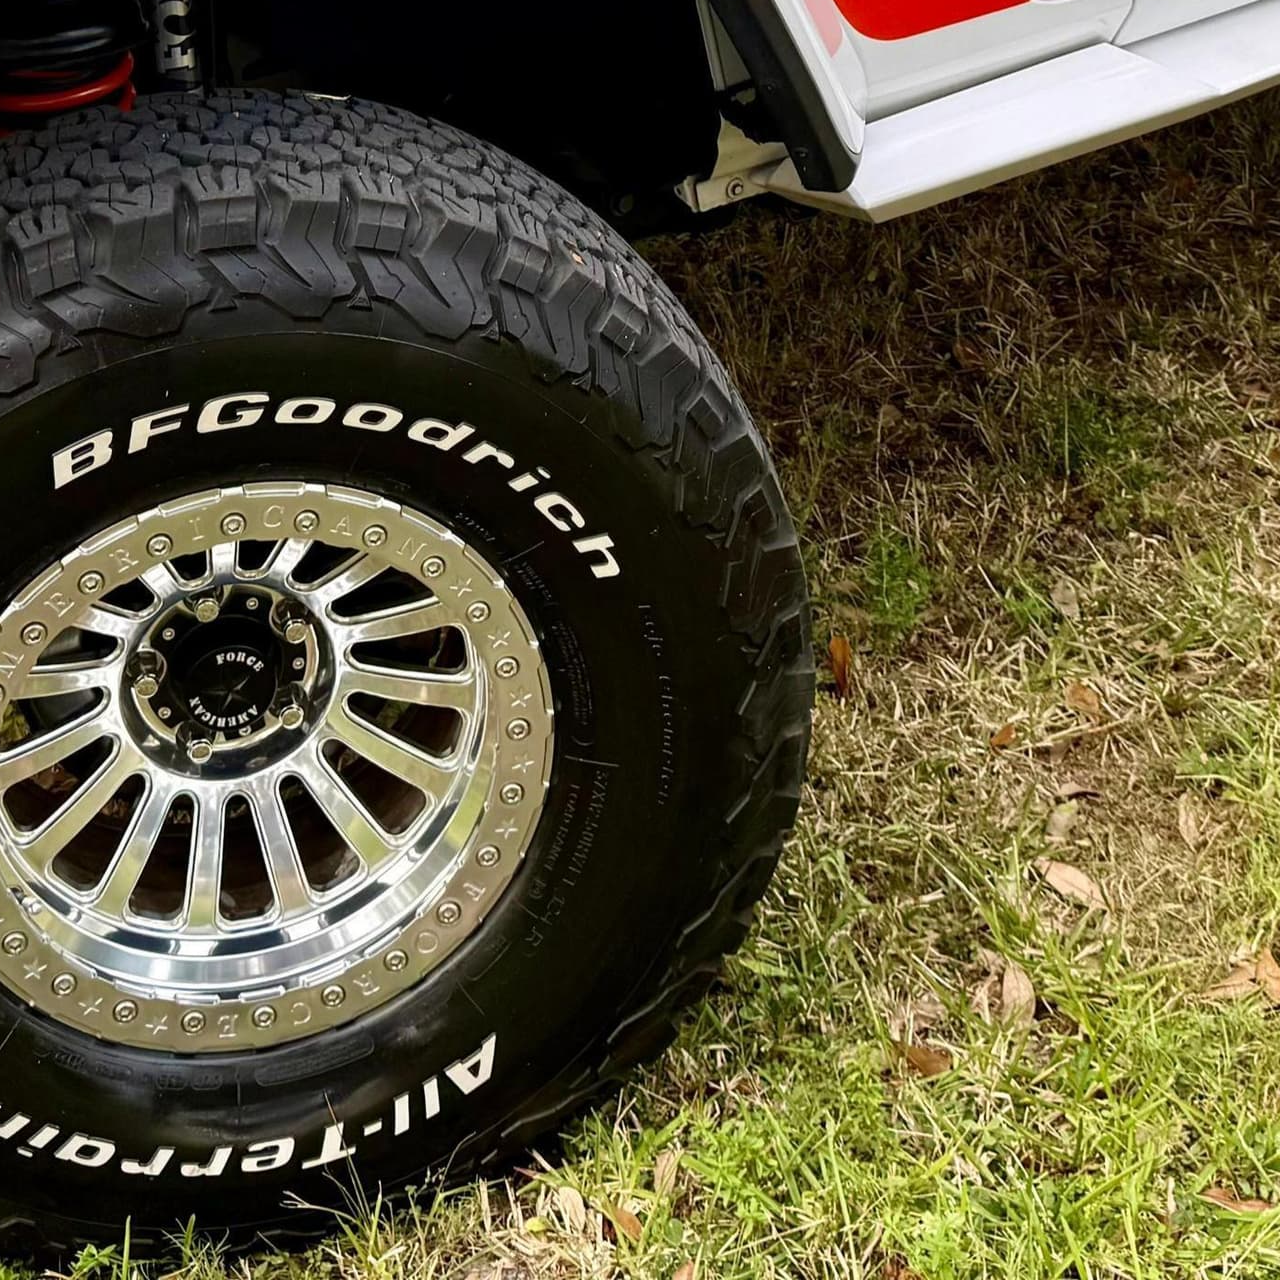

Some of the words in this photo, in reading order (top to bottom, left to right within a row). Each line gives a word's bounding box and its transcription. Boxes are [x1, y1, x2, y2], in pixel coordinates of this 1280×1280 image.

[52, 391, 621, 581] BFGoodrich
[215, 651, 265, 672] FORCE
[188, 696, 259, 728] AMERICAN
